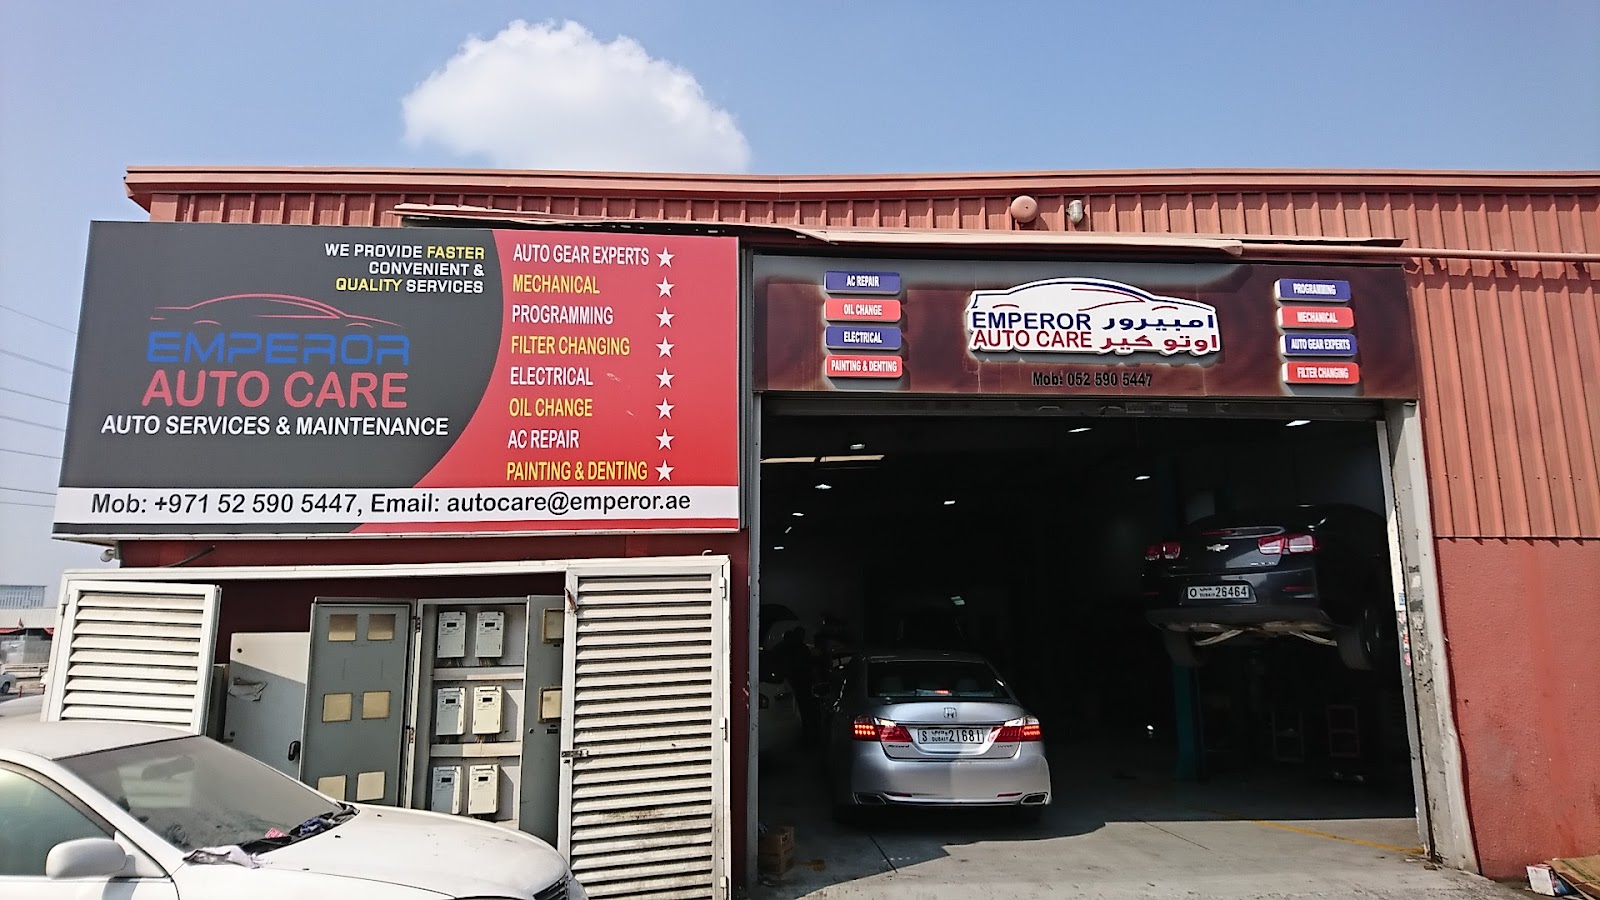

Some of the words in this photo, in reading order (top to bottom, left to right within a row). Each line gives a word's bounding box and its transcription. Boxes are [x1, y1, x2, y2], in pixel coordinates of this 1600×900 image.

[325, 243, 349, 257] WE
[354, 244, 422, 258] PROVIDE
[427, 246, 485, 260] FASTER
[512, 244, 550, 263] AUTO
[553, 244, 590, 264] GEAR
[592, 246, 649, 266] EXPERTS
[369, 262, 469, 277] CONVENIENT
[473, 264, 485, 277] &
[335, 278, 402, 292] QUALITY
[406, 279, 484, 294] SERVICES
[512, 274, 600, 294] MECHANICAL
[846, 275, 856, 287] AC
[857, 275, 880, 287] REPAIR
[1293, 283, 1337, 295] PROGRAMMING
[512, 304, 614, 325] PROGRAMMING
[843, 304, 855, 315] OIL
[855, 304, 882, 316] CHANGE
[1296, 312, 1338, 323] MECHANICAL
[972, 311, 1091, 330] EMPEROR
[1102, 315, 1214, 331] امبيرور
[843, 331, 882, 343] ELECTRICAL
[973, 330, 1030, 348] AUTO
[1036, 331, 1093, 348] CARE
[1100, 334, 1153, 350] كير
[1164, 335, 1217, 351] اوتو
[1291, 338, 1307, 350] AUTO
[1308, 338, 1324, 350] GEAR
[1324, 339, 1351, 350] EXPERTS
[147, 331, 411, 366] EMPEROR
[511, 335, 556, 355] FILTER
[558, 336, 631, 356] CHANGING
[831, 360, 861, 371] PAINTING
[862, 360, 868, 372] &
[869, 361, 897, 372] DENTING
[1296, 367, 1318, 378] FILTER
[1318, 367, 1349, 379] CHANGING
[509, 366, 594, 386] ELECTRICAL
[1032, 371, 1063, 386] Mob:
[1067, 372, 1091, 386] 052
[1094, 373, 1117, 387] 590
[1122, 373, 1153, 387] 5447
[142, 370, 270, 408] AUTO
[283, 372, 409, 409] CARE
[509, 397, 532, 417] OIL
[535, 398, 593, 417] CHANGE
[100, 415, 160, 435] AUTO
[165, 415, 270, 436] SERVICES
[276, 416, 292, 435] &
[296, 417, 449, 436] MAINTENANCE
[507, 429, 528, 449] AC
[530, 429, 580, 449] REPAIR
[506, 461, 571, 481] PAINTING
[574, 461, 585, 480] &
[587, 461, 648, 481] DENTING
[91, 493, 147, 513] Mob:
[154, 493, 208, 513] +971
[217, 493, 246, 513] 52
[252, 493, 294, 513] 590
[300, 493, 362, 518] 5447,
[371, 493, 440, 513] Email:
[447, 491, 691, 516] autocare@emperor.ae
[1215, 586, 1247, 598] 26464
[922, 730, 928, 741] S
[948, 730, 981, 742] 21681
